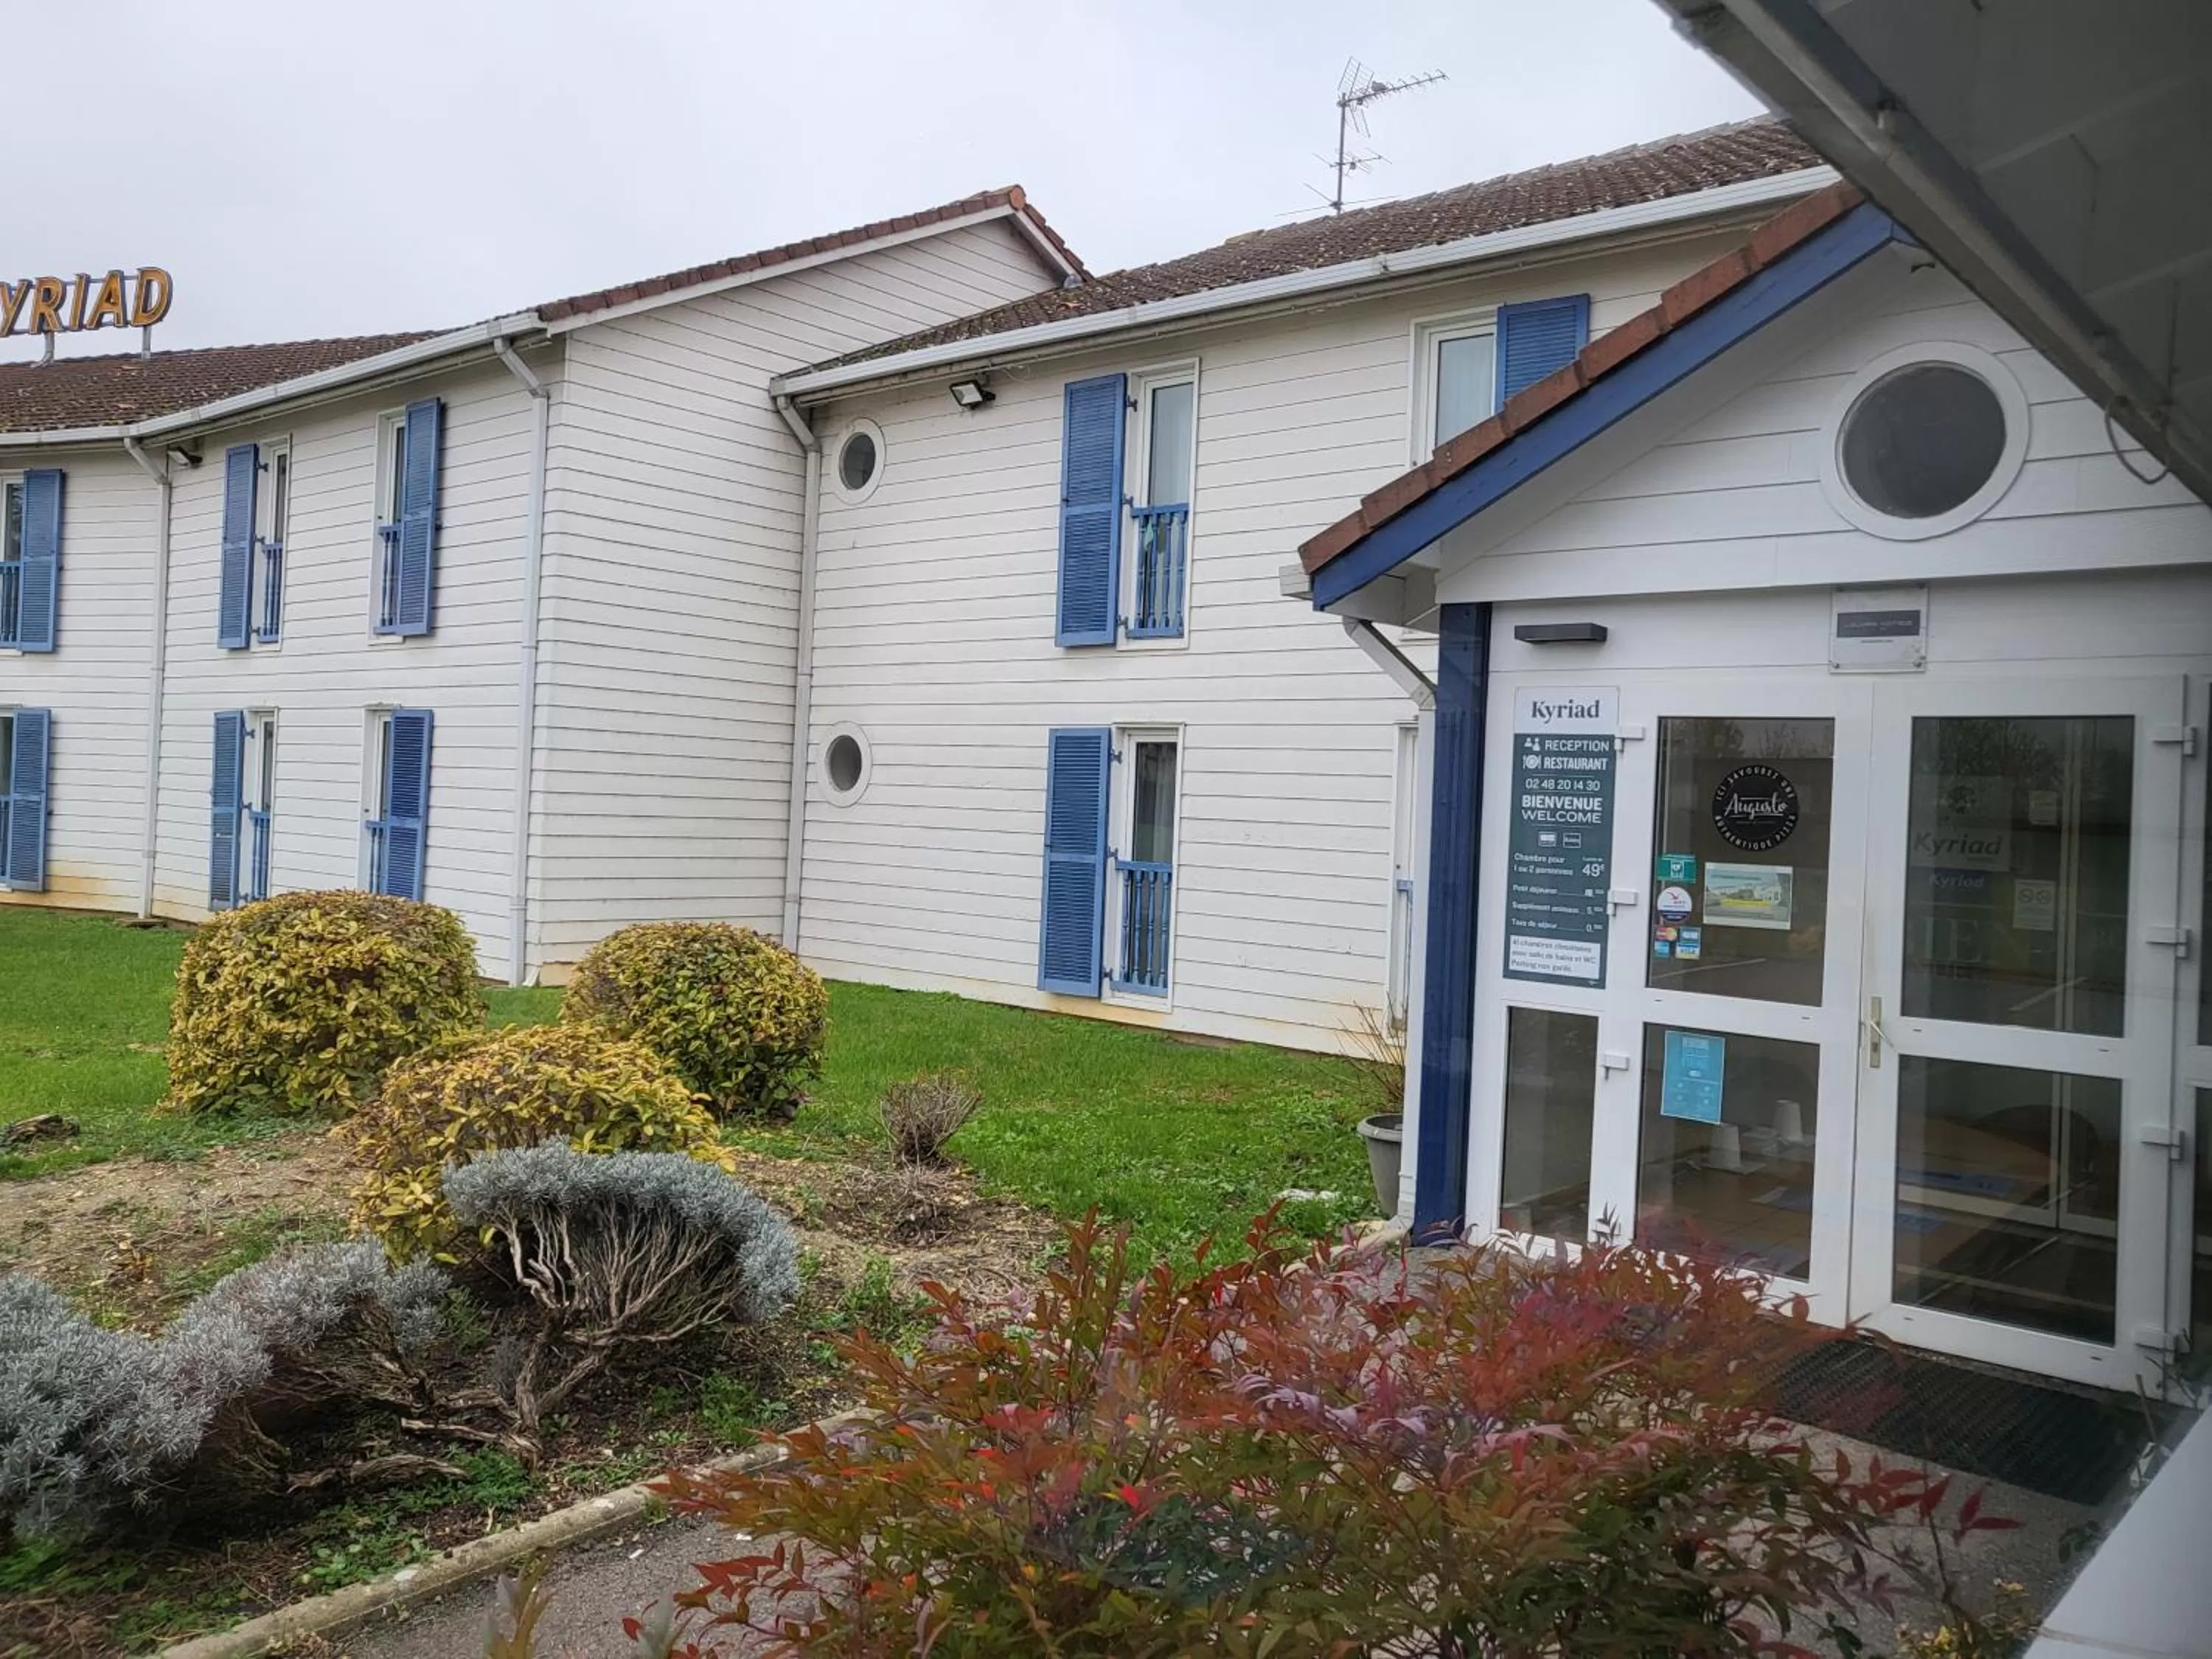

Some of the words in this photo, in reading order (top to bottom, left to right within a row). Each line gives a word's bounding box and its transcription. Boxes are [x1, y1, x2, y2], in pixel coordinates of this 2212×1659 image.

[1531, 698, 1600, 724] Kyriad
[1545, 740, 1610, 751] RECEPTION
[1544, 757, 1608, 771] RESTAURANT
[1526, 778, 1540, 790] 02
[1541, 779, 1555, 790] 48
[1557, 779, 1571, 790] 20
[1573, 780, 1584, 790] 14
[1586, 780, 1601, 791] 30
[1521, 795, 1604, 810] BIENVENUE
[1723, 791, 1789, 820] Augusto
[1521, 809, 1602, 824] WELCOME
[1913, 830, 2003, 857] Kyriad
